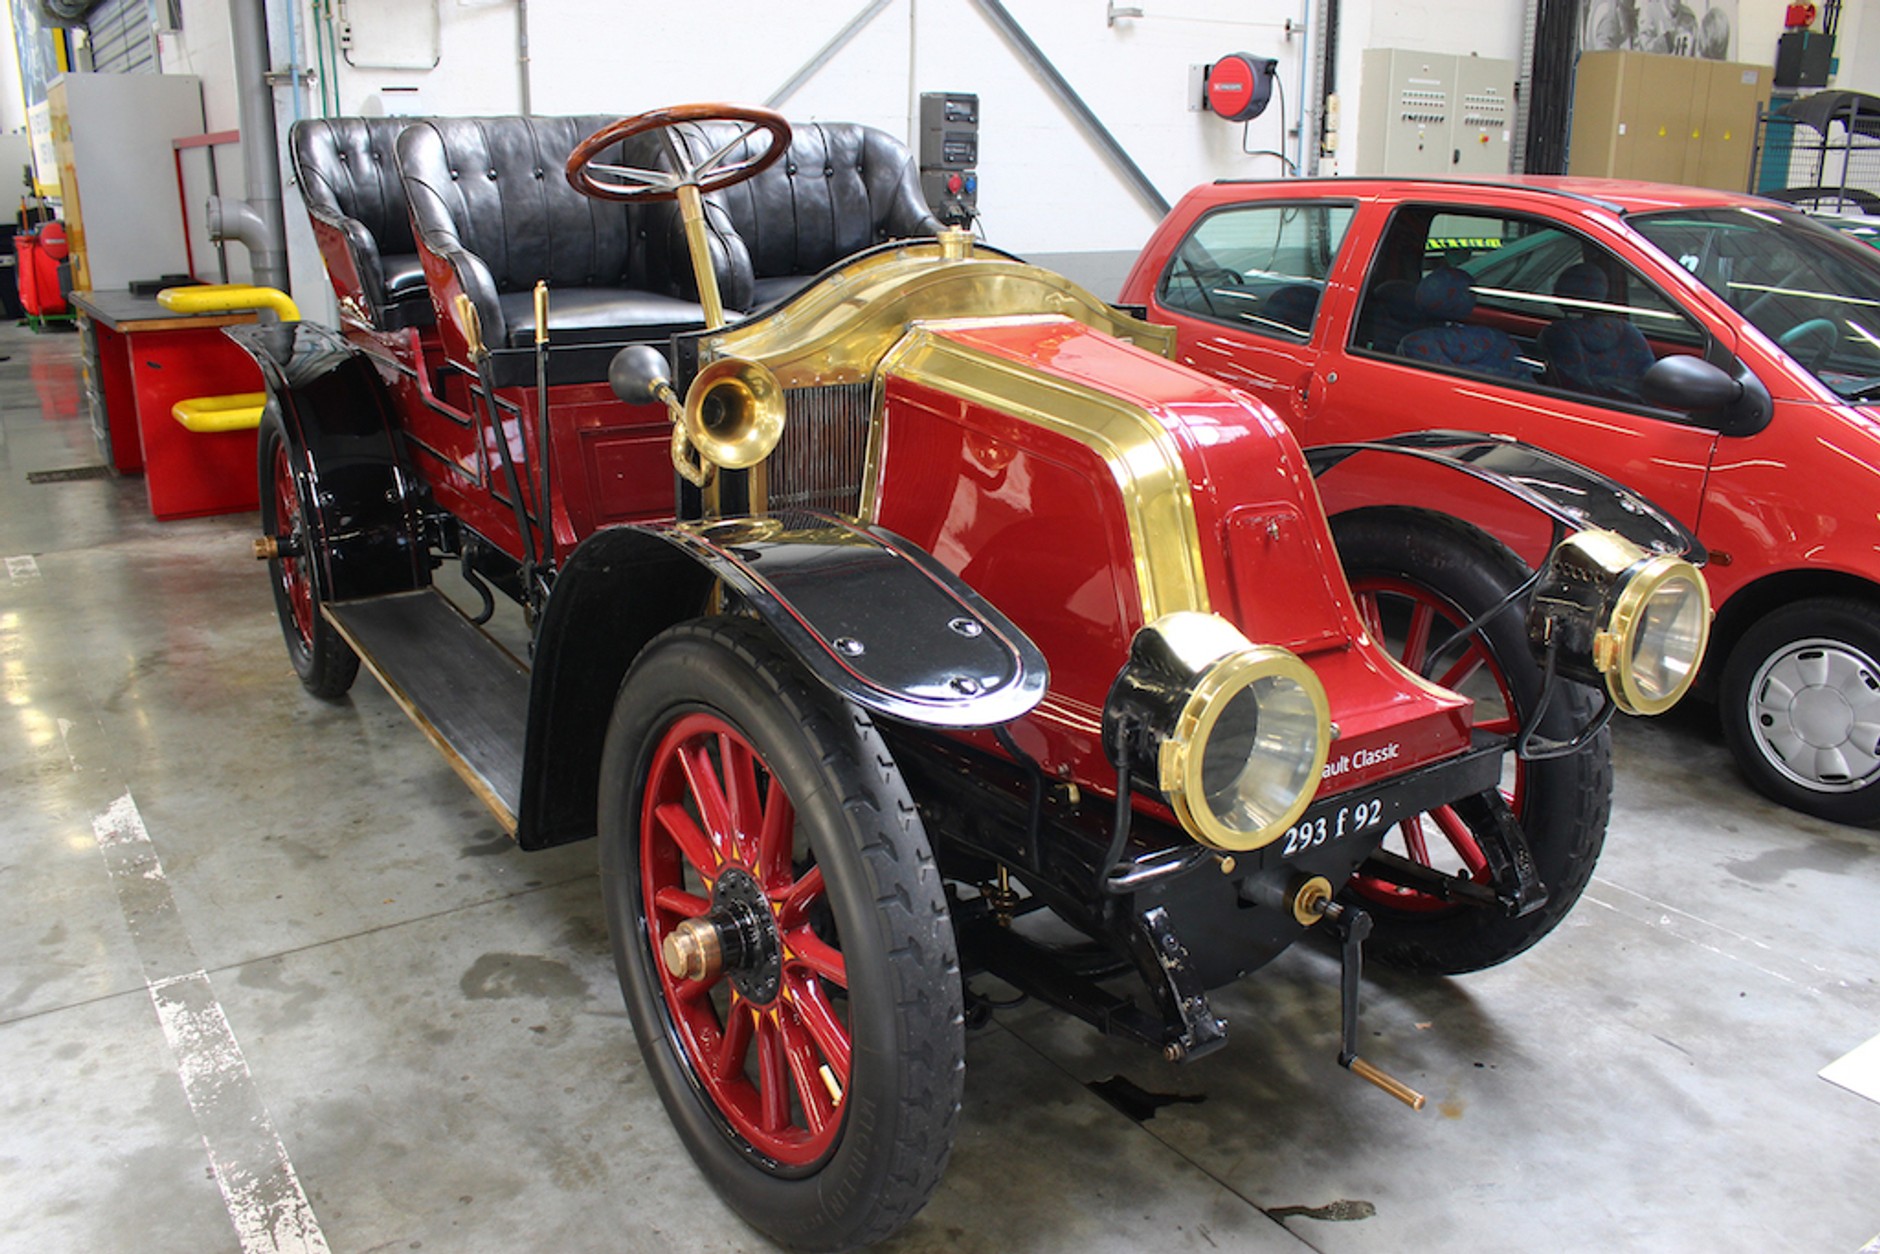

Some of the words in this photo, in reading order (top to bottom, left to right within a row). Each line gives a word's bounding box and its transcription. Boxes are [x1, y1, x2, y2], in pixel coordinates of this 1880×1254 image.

[1321, 756, 1350, 778] ault
[1353, 743, 1399, 769] Classic
[1283, 818, 1327, 855] 293
[1336, 808, 1348, 837] f
[1355, 799, 1381, 831] 92
